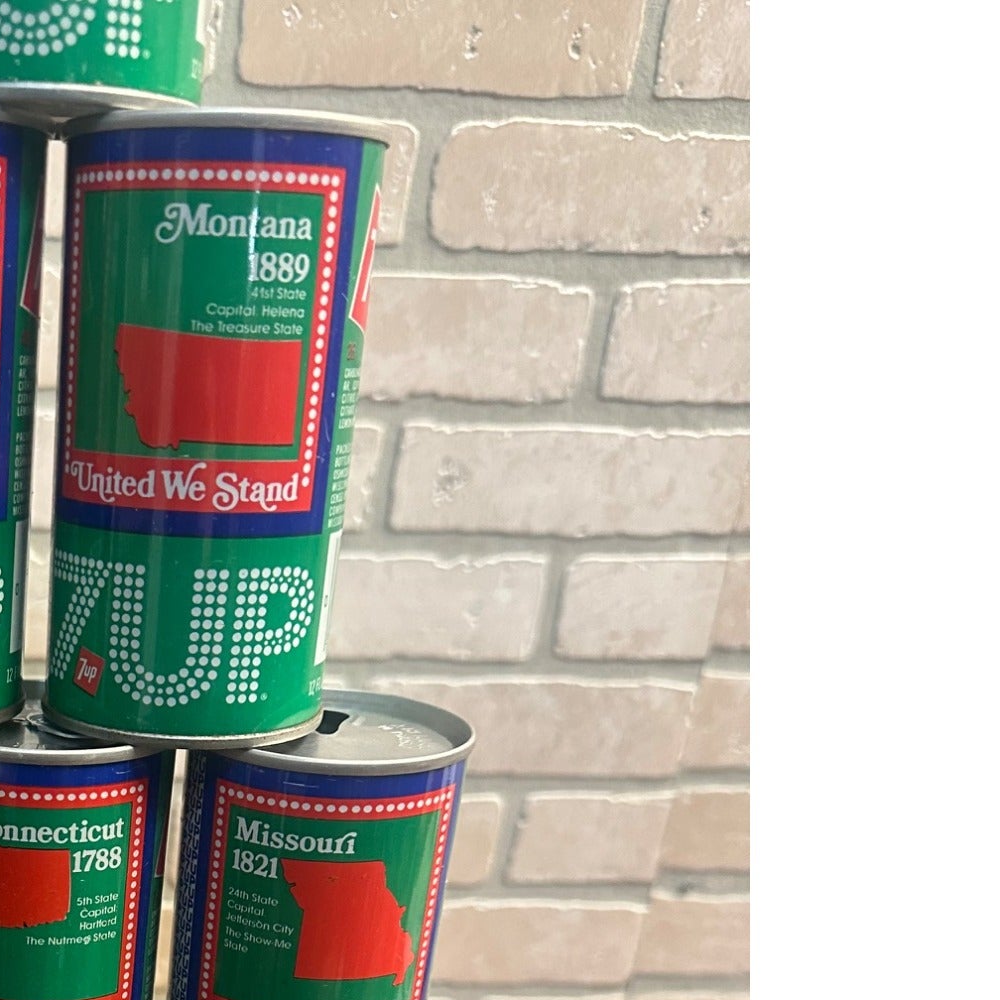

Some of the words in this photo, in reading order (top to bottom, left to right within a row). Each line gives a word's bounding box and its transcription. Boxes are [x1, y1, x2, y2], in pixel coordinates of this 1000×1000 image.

[155, 202, 313, 244] Montana
[249, 252, 311, 285] 1889
[251, 286, 275, 300] 41st
[277, 287, 307, 301] State
[261, 304, 305, 318] Helena
[190, 319, 214, 333] The
[217, 320, 271, 335] Treasure
[273, 322, 304, 335] State
[70, 461, 156, 503] United
[161, 462, 207, 501] We
[212, 472, 300, 512] Stand
[52, 548, 315, 708] 7UP
[78, 659, 98, 682] 7up
[234, 816, 358, 855] Missouri
[72, 846, 122, 873] 1788
[231, 848, 279, 880] 1821
[77, 896, 93, 907] 5th
[95, 892, 119, 905] State
[228, 885, 250, 901] 24th
[251, 892, 279, 907] State
[79, 916, 117, 931] Hartford
[225, 912, 270, 931] Jefferson
[272, 922, 295, 936] City
[26, 936, 46, 946] The
[48, 934, 92, 946] Nutmeg
[93, 930, 117, 943] State
[223, 938, 249, 953] State
[225, 926, 242, 939] The
[243, 931, 292, 950] Show-Me
